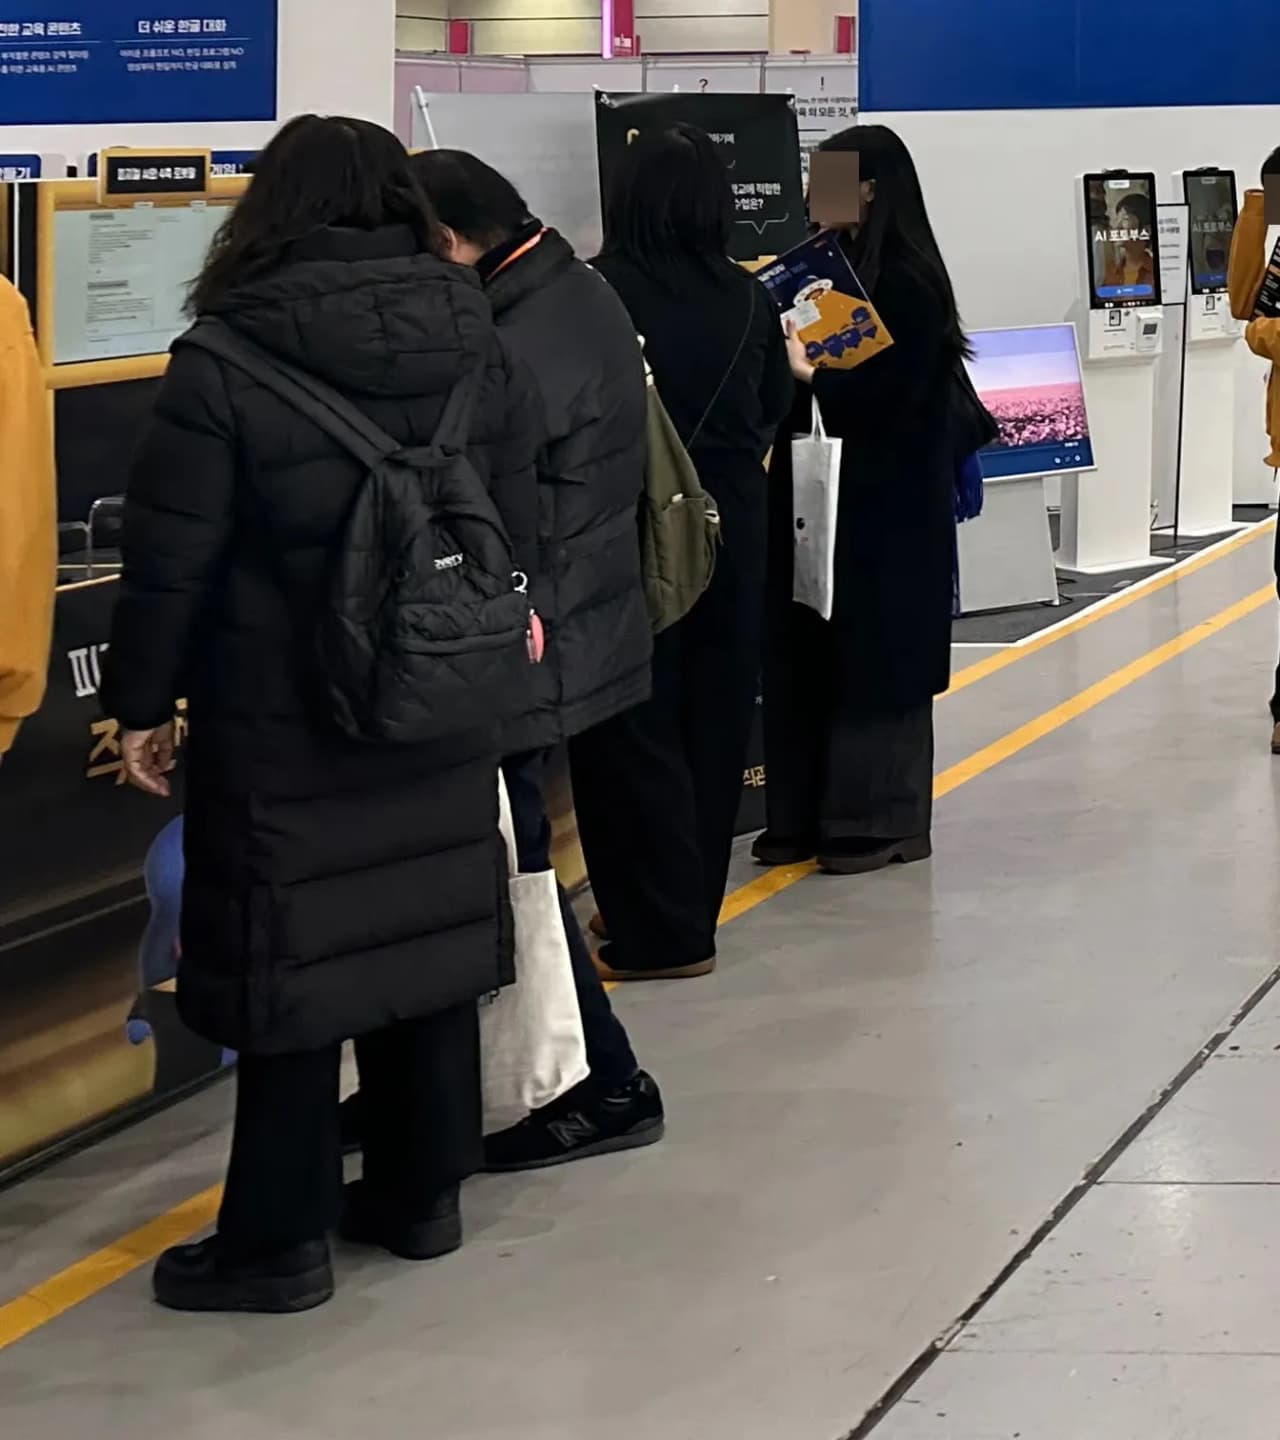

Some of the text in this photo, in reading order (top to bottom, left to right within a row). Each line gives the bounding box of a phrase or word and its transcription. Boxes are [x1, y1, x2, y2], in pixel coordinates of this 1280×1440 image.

[22, 22, 45, 36] 교육
[138, 21, 150, 34] 더
[152, 20, 177, 34] 쉬운
[202, 19, 227, 32] 대화
[1094, 229, 1150, 242] AI 포토부스
